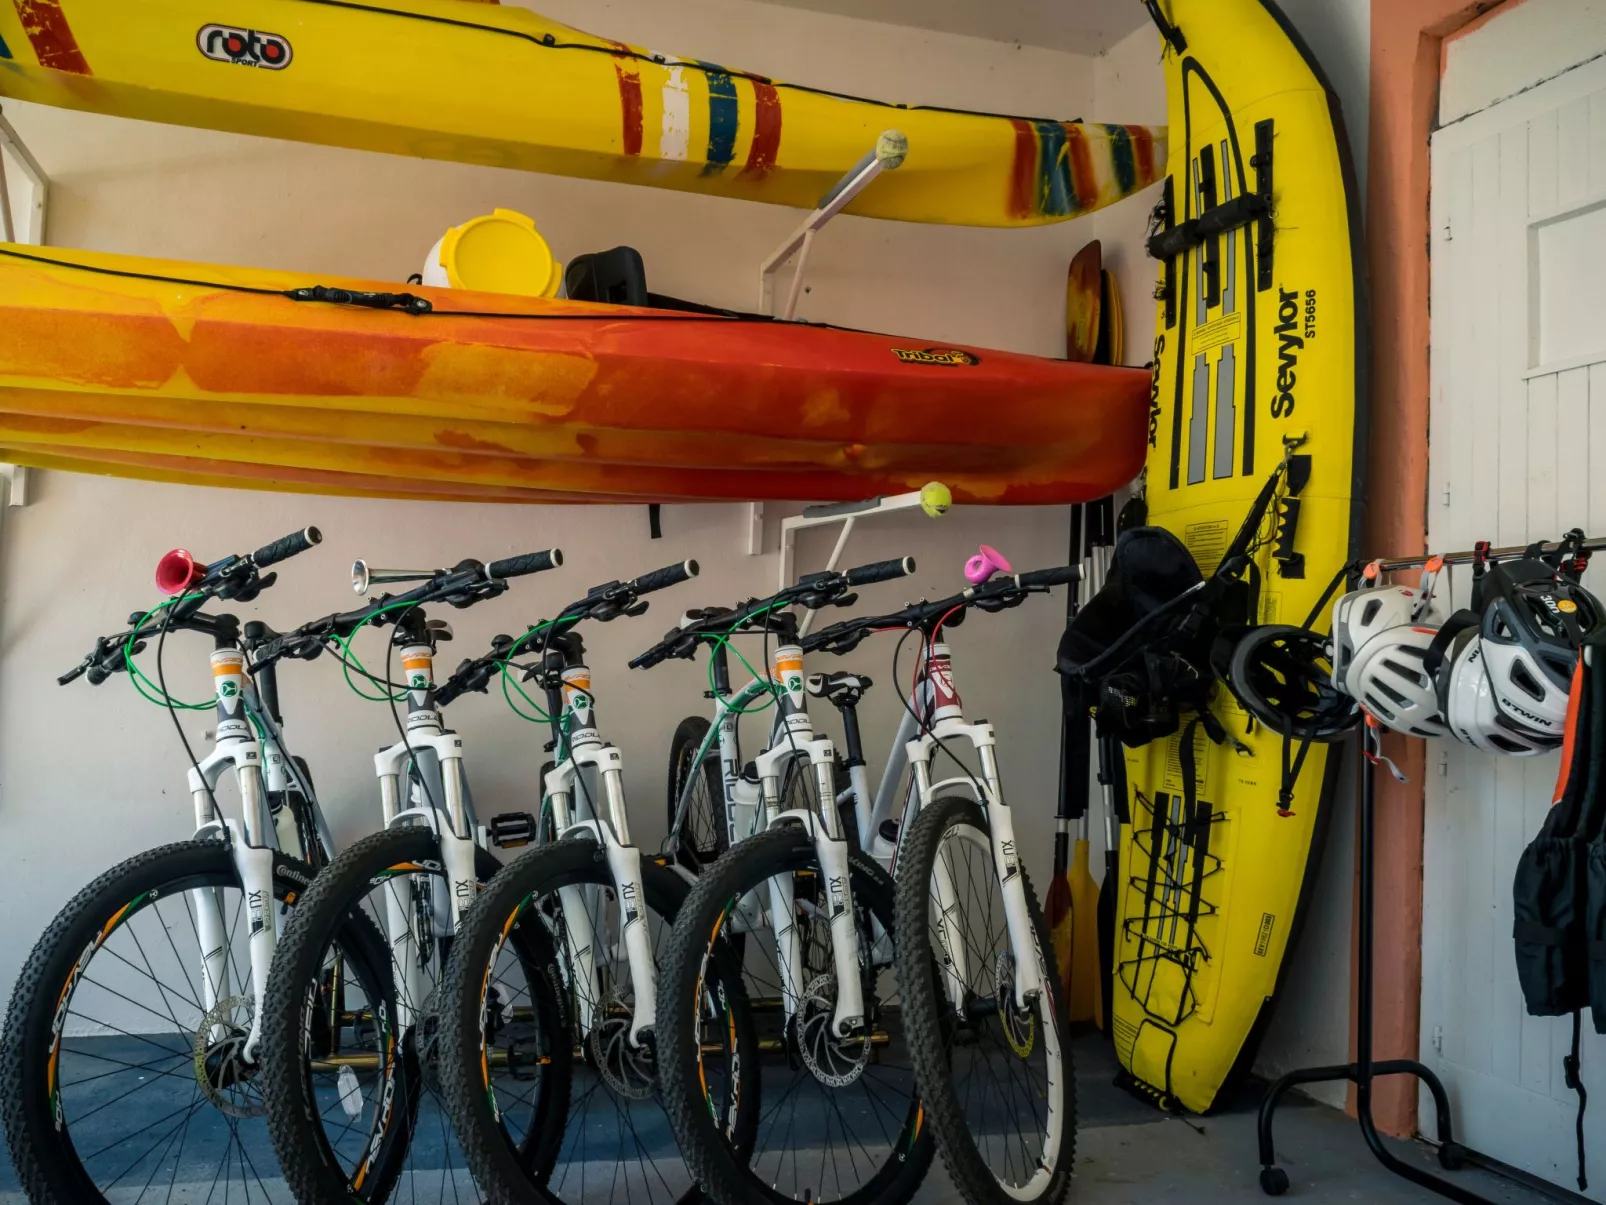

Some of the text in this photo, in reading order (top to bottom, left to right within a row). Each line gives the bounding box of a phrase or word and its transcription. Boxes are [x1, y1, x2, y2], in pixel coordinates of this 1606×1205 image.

[206, 28, 286, 64] roto
[230, 57, 260, 68] SPORT
[1304, 289, 1317, 339] ST5656
[891, 348, 954, 365] Tribal
[1271, 289, 1304, 419] Sevylor
[1540, 594, 1560, 613] 300
[1502, 698, 1552, 727] BTWIN
